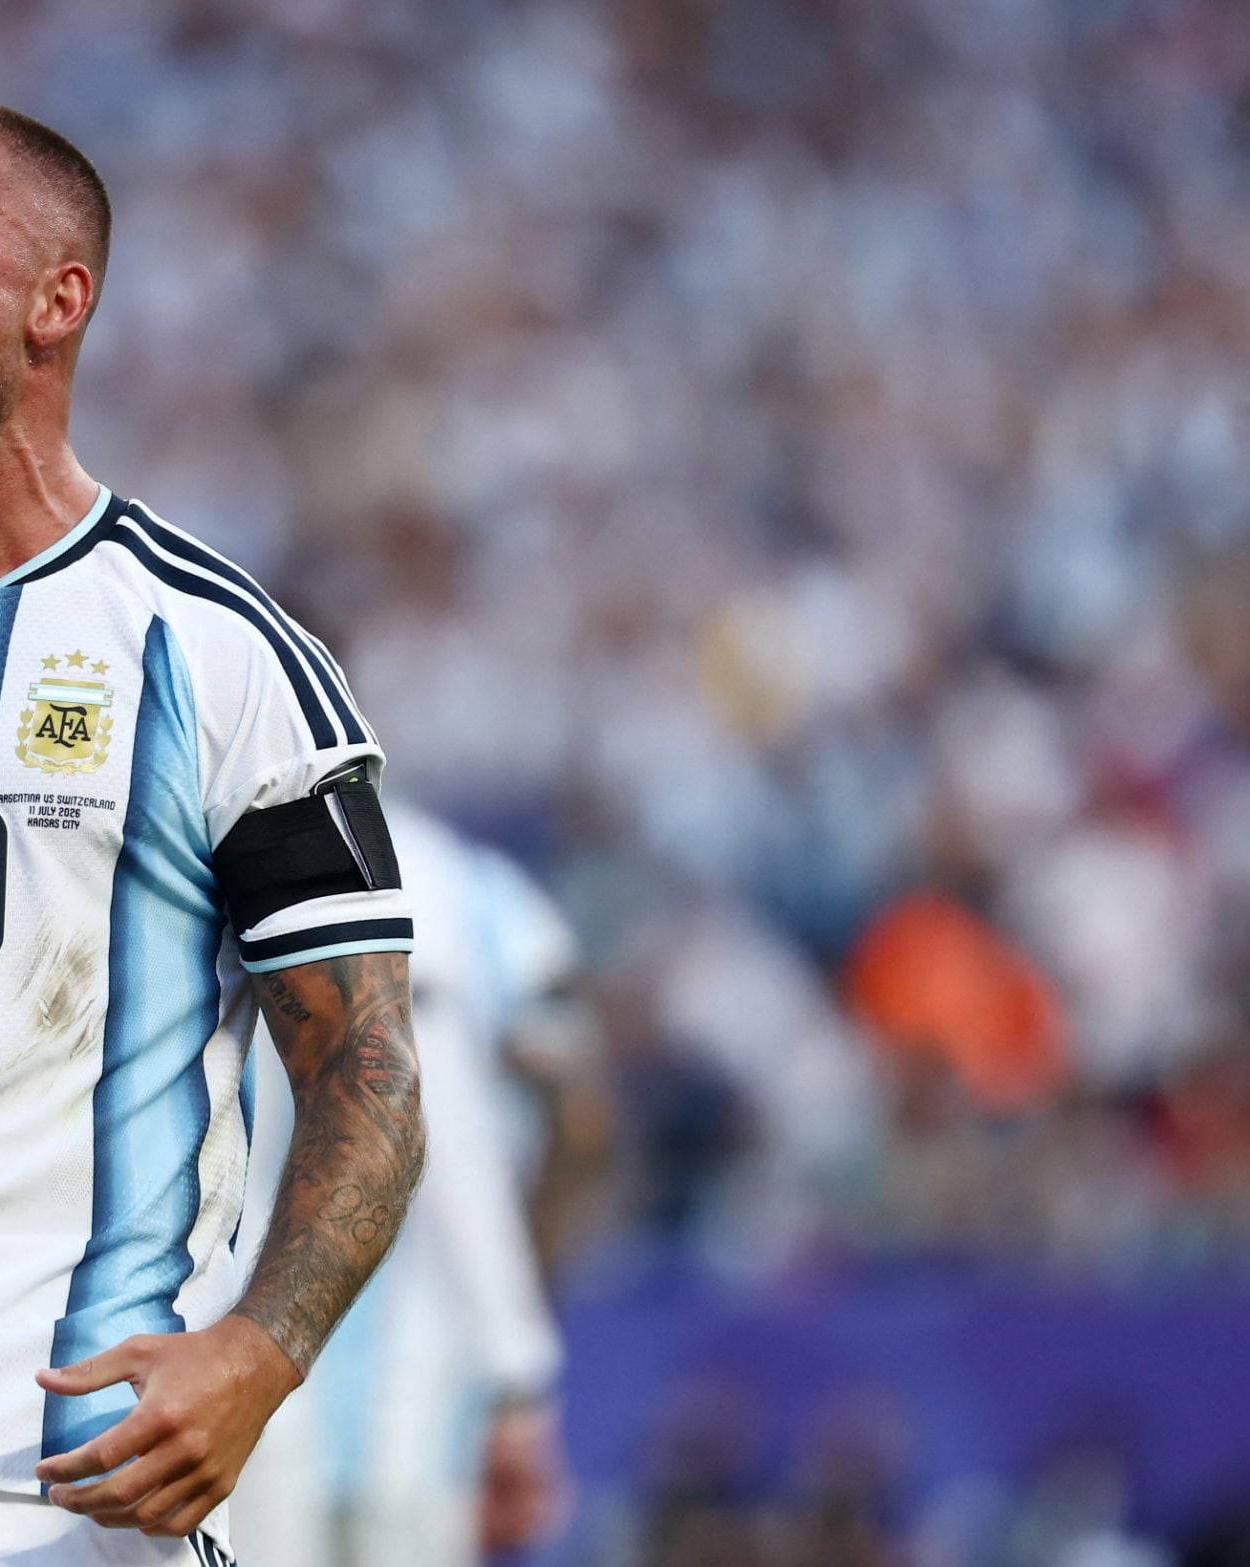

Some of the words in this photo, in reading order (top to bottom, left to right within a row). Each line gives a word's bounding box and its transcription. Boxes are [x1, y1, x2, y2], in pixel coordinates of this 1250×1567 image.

[35, 703, 92, 748] AFA
[56, 795, 116, 811] SWITZERLAND
[29, 805, 36, 815] 11
[37, 806, 57, 816] JULY
[58, 807, 81, 818] 2026
[27, 817, 60, 829] KANSAS
[62, 819, 81, 830] CITY
